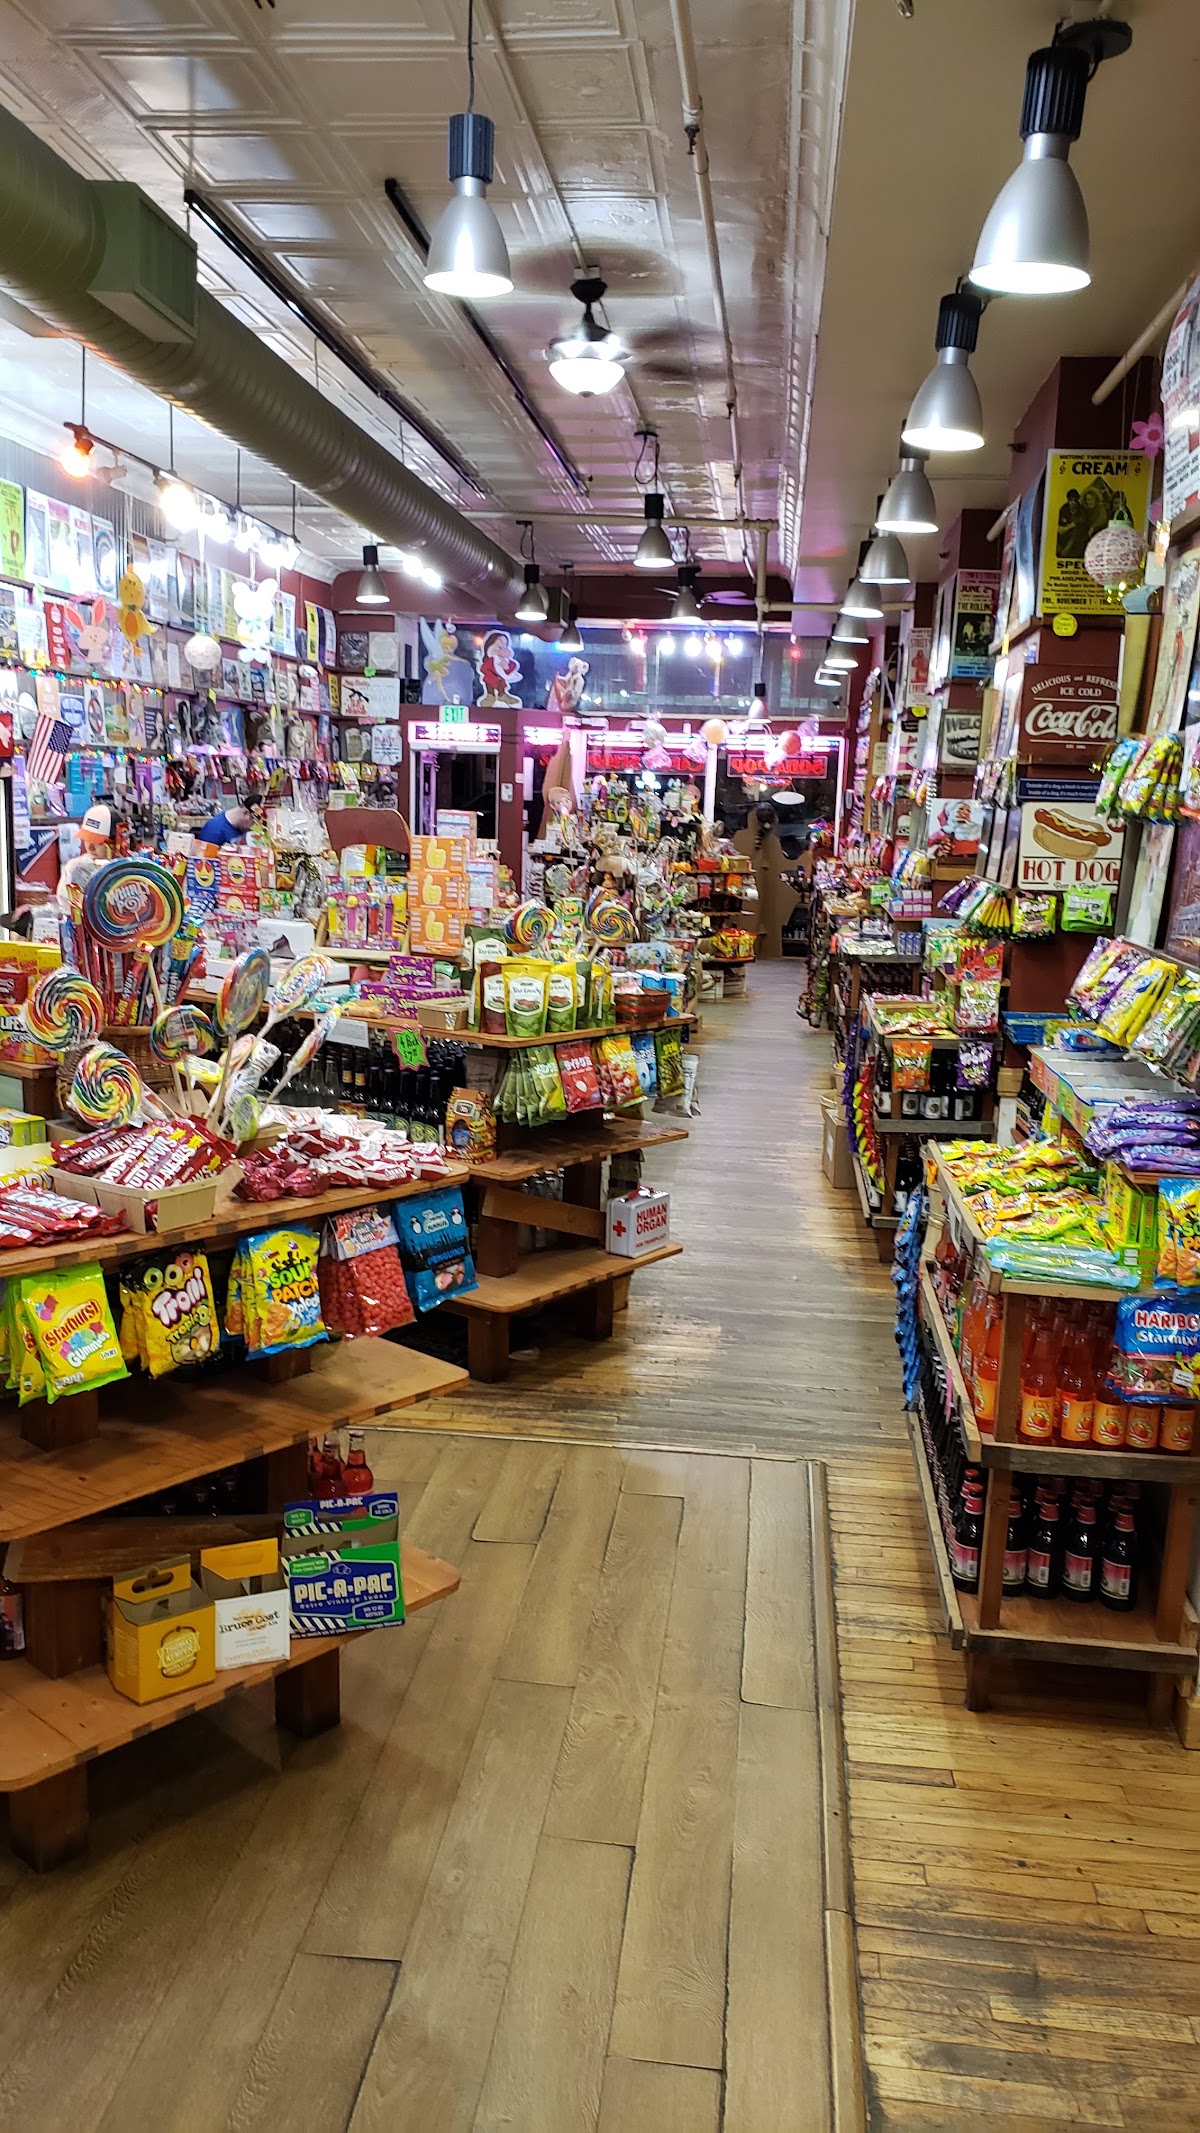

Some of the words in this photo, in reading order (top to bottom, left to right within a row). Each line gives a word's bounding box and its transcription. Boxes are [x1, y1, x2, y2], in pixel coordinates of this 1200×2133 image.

[1071, 461, 1128, 476] CREAM
[960, 585, 981, 593] JUNE
[1031, 674, 1072, 695] DELICIOUS
[1060, 686, 1075, 696] ICE
[1078, 687, 1102, 697] COLD
[443, 706, 466, 723] EXIT
[1023, 859, 1066, 881] HOT
[1075, 861, 1120, 883] DOG
[105, 881, 152, 906] WHIRLY
[636, 1202, 668, 1223] HUMAN
[636, 1214, 667, 1236] ORGAN
[427, 1246, 466, 1266] PENGUINS
[270, 1262, 312, 1289] SOUR
[152, 1266, 207, 1327] Trolli
[271, 1278, 319, 1304] PATCH
[44, 1300, 100, 1348] Starburst
[1136, 1310, 1200, 1331] HARIBO
[1139, 1329, 1195, 1346] Starmix
[300, 1602, 324, 1610] Retro
[327, 1597, 360, 1606] Vintage
